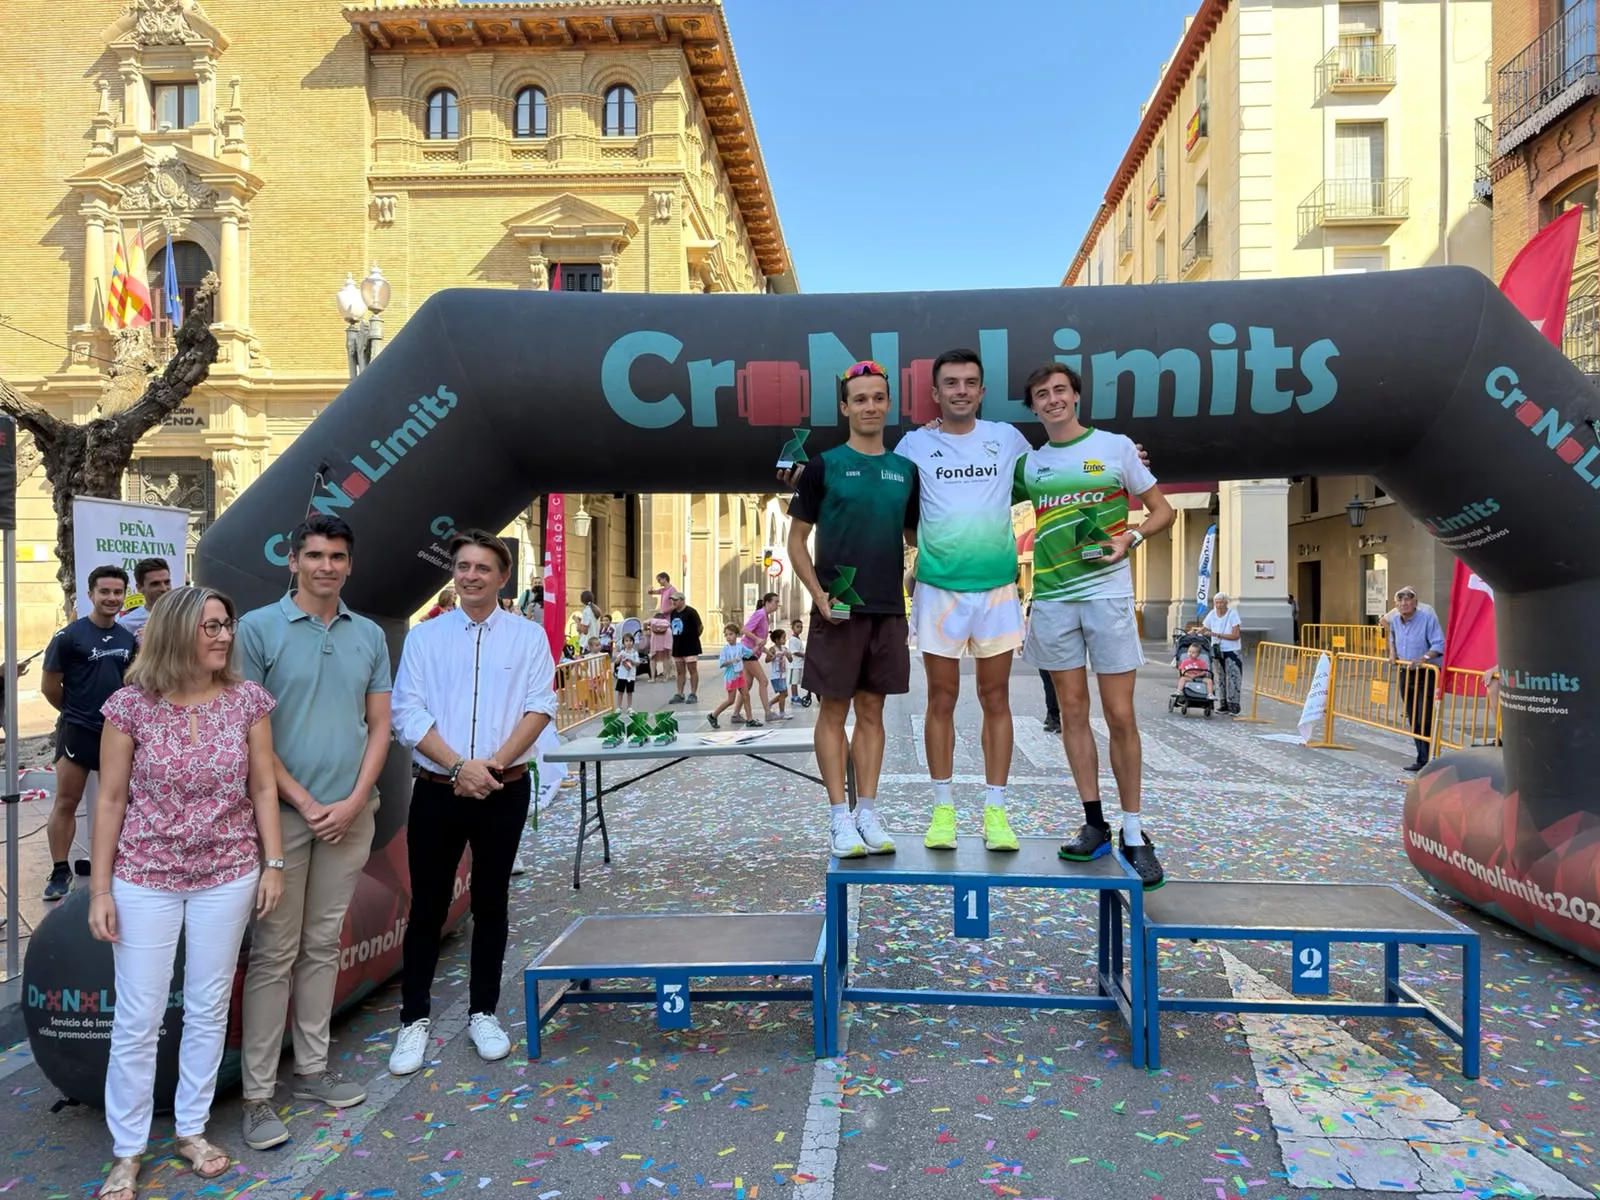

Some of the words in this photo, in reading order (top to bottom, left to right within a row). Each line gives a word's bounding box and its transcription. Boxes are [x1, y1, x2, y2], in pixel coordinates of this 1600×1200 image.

[936, 463, 998, 480] fondavi
[1038, 490, 1105, 509] Huesca
[119, 519, 156, 538] PEÑA
[95, 538, 177, 556] RECREATIVA
[121, 557, 140, 571] ZO
[1527, 705, 1569, 715] deportivos
[962, 890, 978, 919] 1
[1299, 948, 1322, 978] 2
[663, 984, 684, 1013] 3
[50, 1016, 81, 1027] Servicio
[82, 1018, 94, 1028] de
